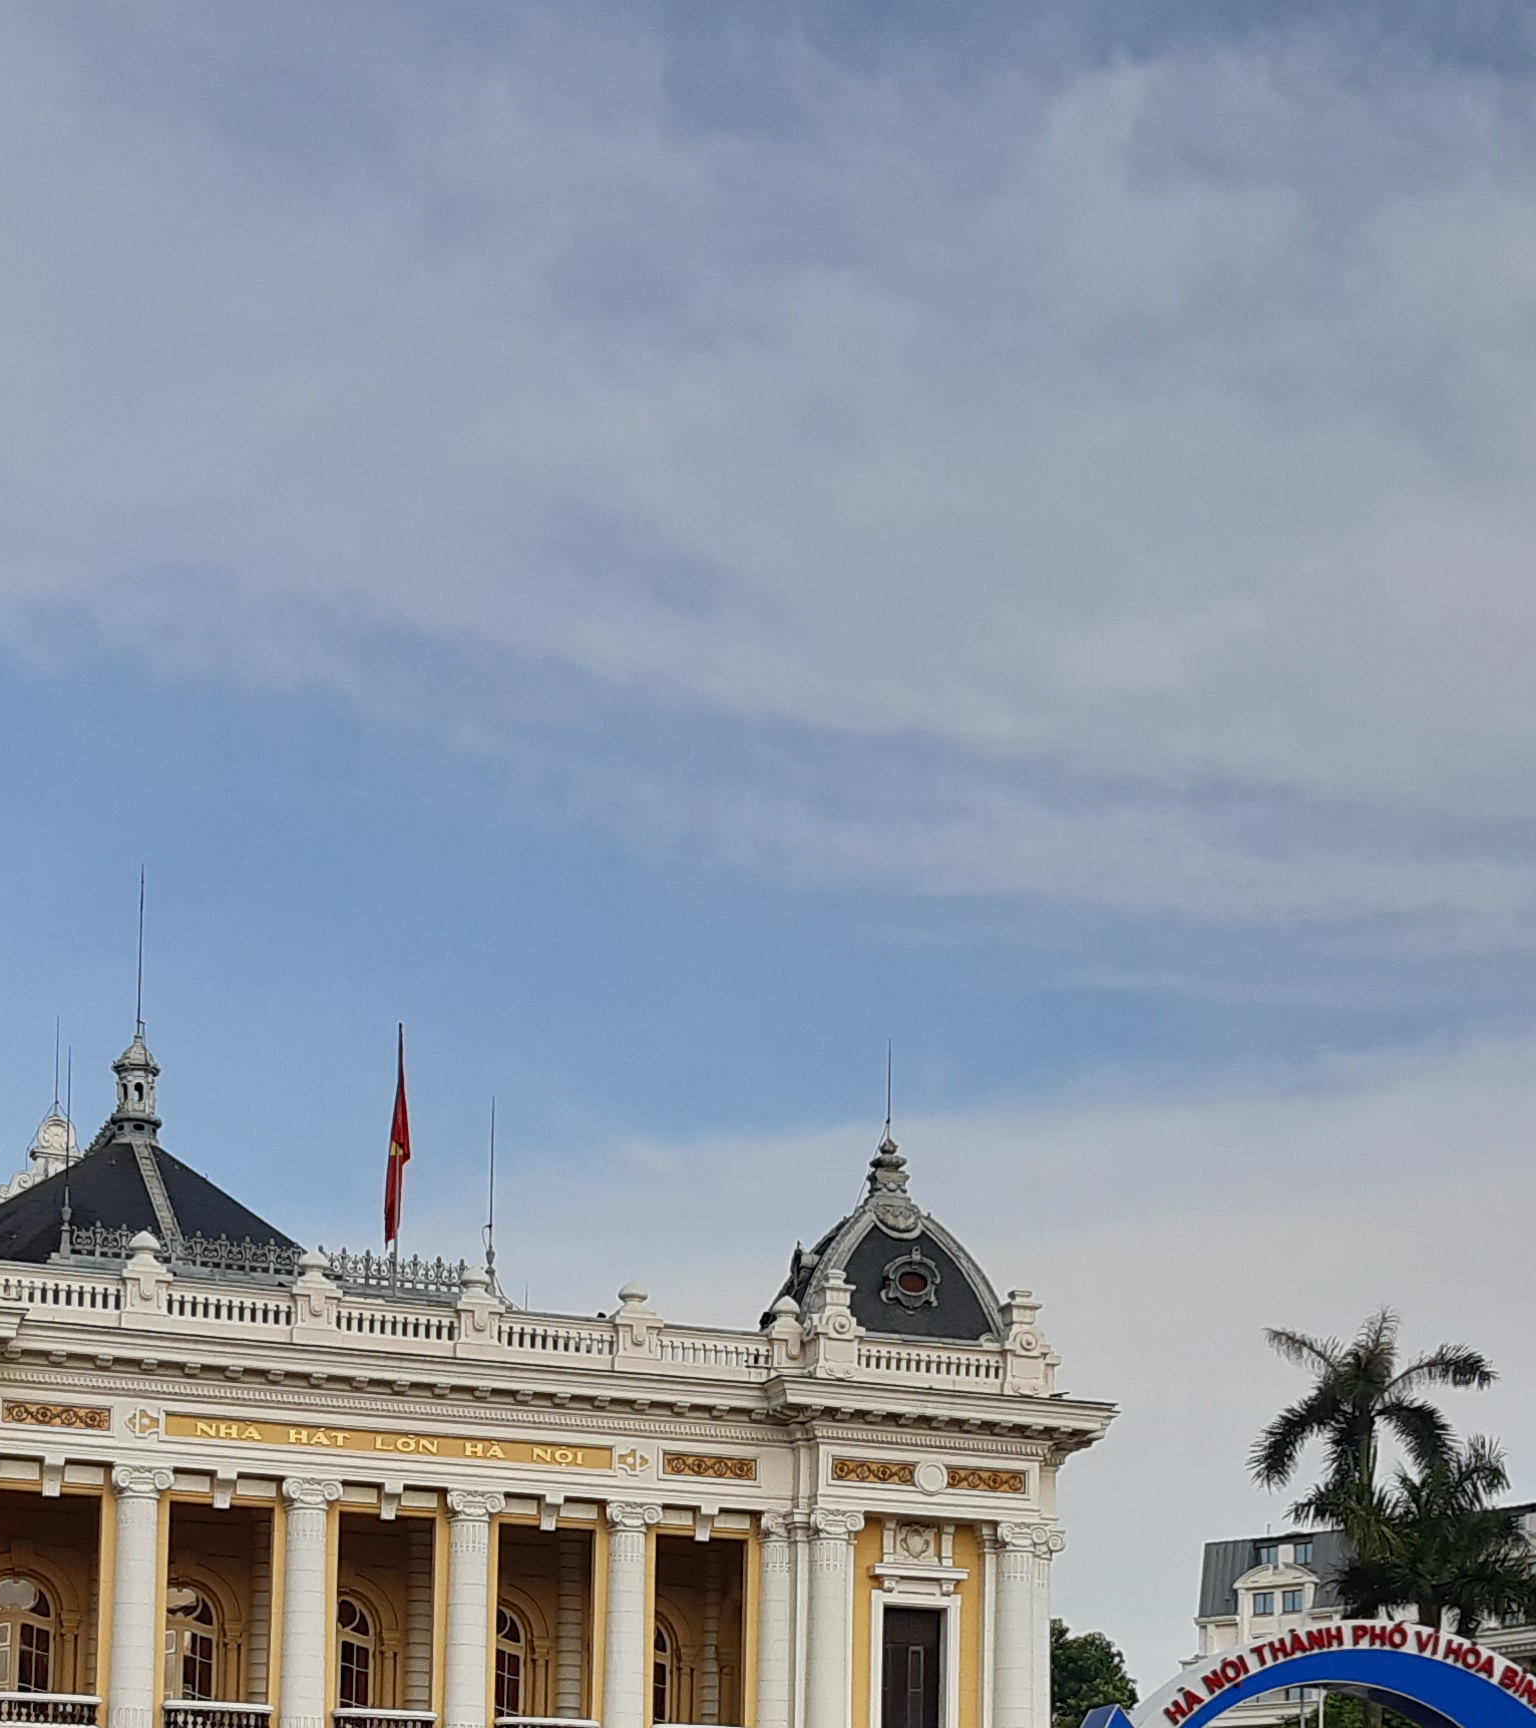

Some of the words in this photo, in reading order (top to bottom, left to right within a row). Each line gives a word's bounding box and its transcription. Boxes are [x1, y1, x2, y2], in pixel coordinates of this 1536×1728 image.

[195, 1421, 263, 1440] NHÀ
[287, 1427, 351, 1446] HÁT
[374, 1434, 439, 1454] LỚN
[464, 1441, 506, 1458] HÀ
[532, 1446, 584, 1467] NỘI
[1163, 1686, 1206, 1726] HÀ
[1201, 1654, 1250, 1695] NỘI
[1249, 1626, 1345, 1668] THÀNH
[1415, 1628, 1441, 1656] VÌ
[1442, 1639, 1495, 1679] HÒA
